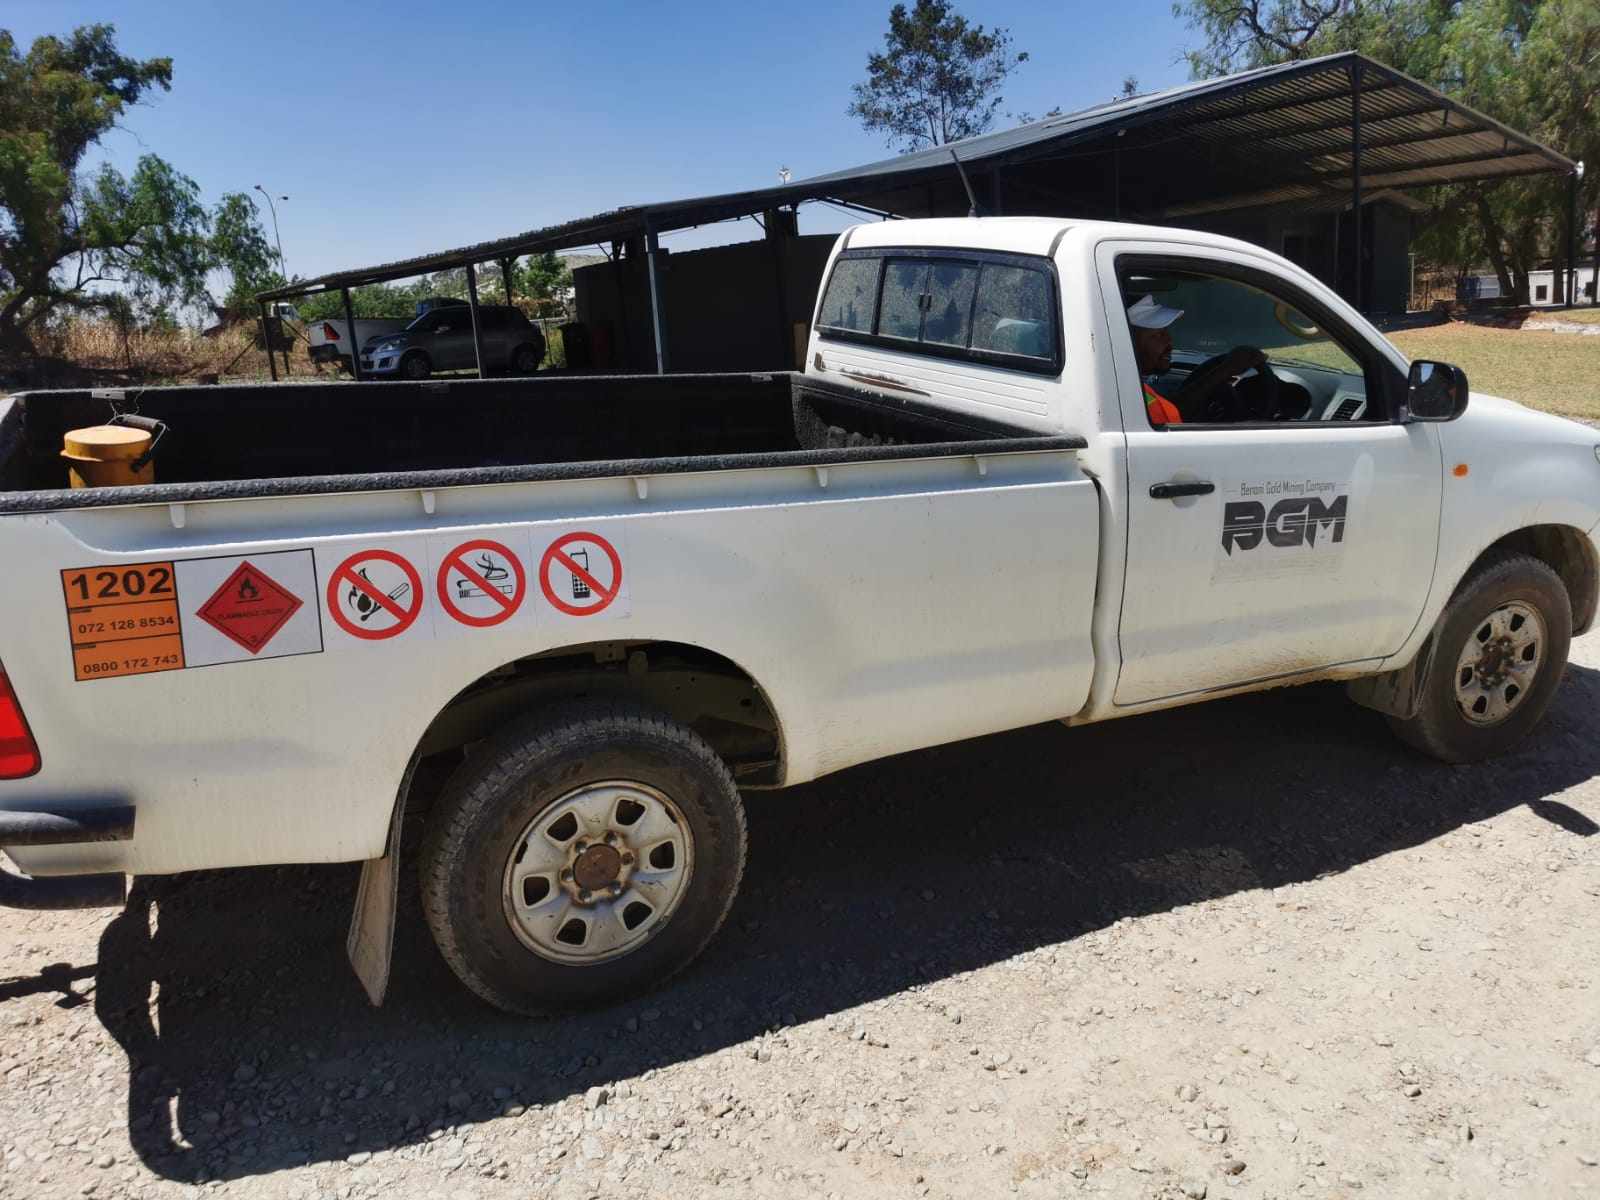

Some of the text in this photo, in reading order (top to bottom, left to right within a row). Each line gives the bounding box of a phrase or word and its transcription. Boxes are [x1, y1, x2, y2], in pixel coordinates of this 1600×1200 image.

[1266, 480, 1281, 495] Gold
[1283, 479, 1304, 496] Mining
[1305, 479, 1336, 493] Company
[1222, 495, 1348, 557] BGM
[71, 567, 172, 600] 1202
[78, 616, 174, 634] 072 128 8534
[83, 654, 178, 674] 0800 172 743
